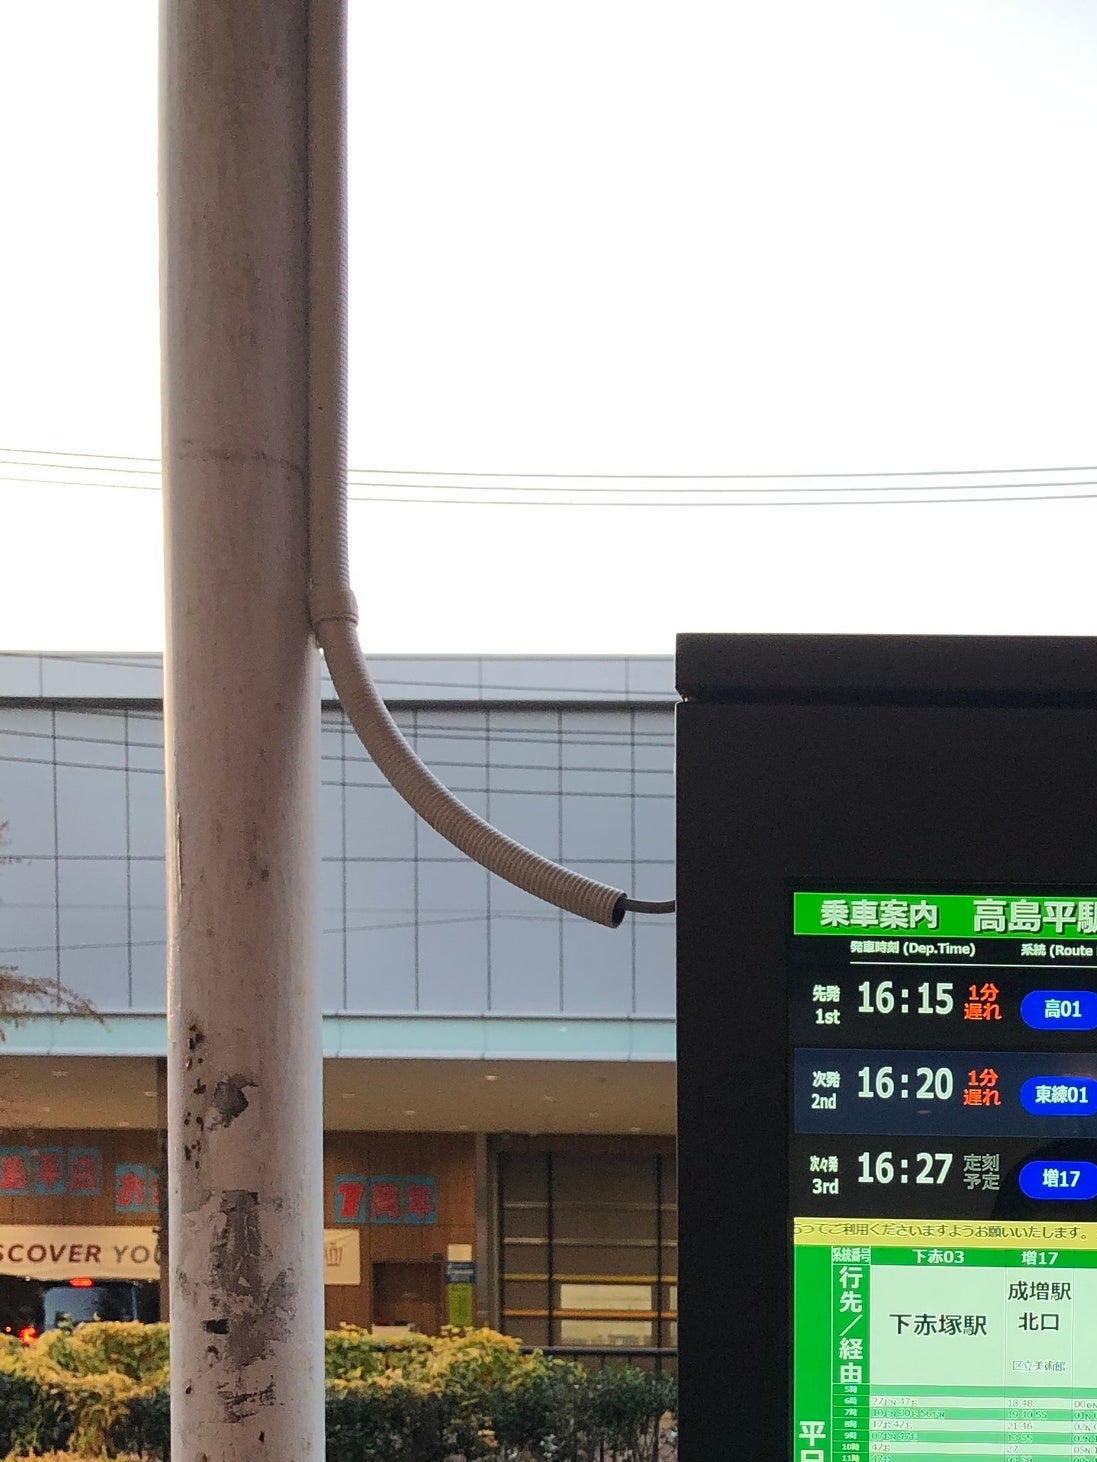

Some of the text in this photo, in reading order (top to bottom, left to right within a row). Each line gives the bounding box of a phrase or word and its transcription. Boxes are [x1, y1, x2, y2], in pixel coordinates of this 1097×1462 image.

[820, 899, 938, 930] 乗車案内
[850, 940, 976, 957] 発車時刻 (Dep.Time)
[1021, 943, 1046, 957] 系統
[1049, 944, 1093, 959] (Route
[812, 985, 841, 1003] 先発
[858, 981, 954, 1015] 16:15
[968, 983, 1000, 1001] 1分
[815, 1008, 841, 1025] 1st
[963, 1002, 1002, 1021] 遅れ
[1044, 999, 1082, 1019] 高01
[812, 1070, 841, 1088] 次発
[857, 1066, 954, 1100] 16:20
[968, 1068, 999, 1086] 1分
[811, 1093, 837, 1110] 2nd
[963, 1088, 1001, 1106] 遅れ
[1035, 1085, 1088, 1105] 東練01
[810, 1155, 839, 1173] 次々発
[857, 1151, 954, 1185] 16:27
[963, 1153, 1001, 1172] 定刻
[812, 1178, 839, 1195] 3rd
[963, 1173, 1001, 1191] 予定
[1042, 1169, 1081, 1188] 増17
[0, 1244, 101, 1264] COVER
[912, 1249, 965, 1264] 下赤03
[1021, 1250, 1059, 1266] 増17
[1008, 1281, 1072, 1301] 成増駅
[889, 1313, 987, 1336] 下赤塚駅
[1018, 1312, 1060, 1332] 北口
